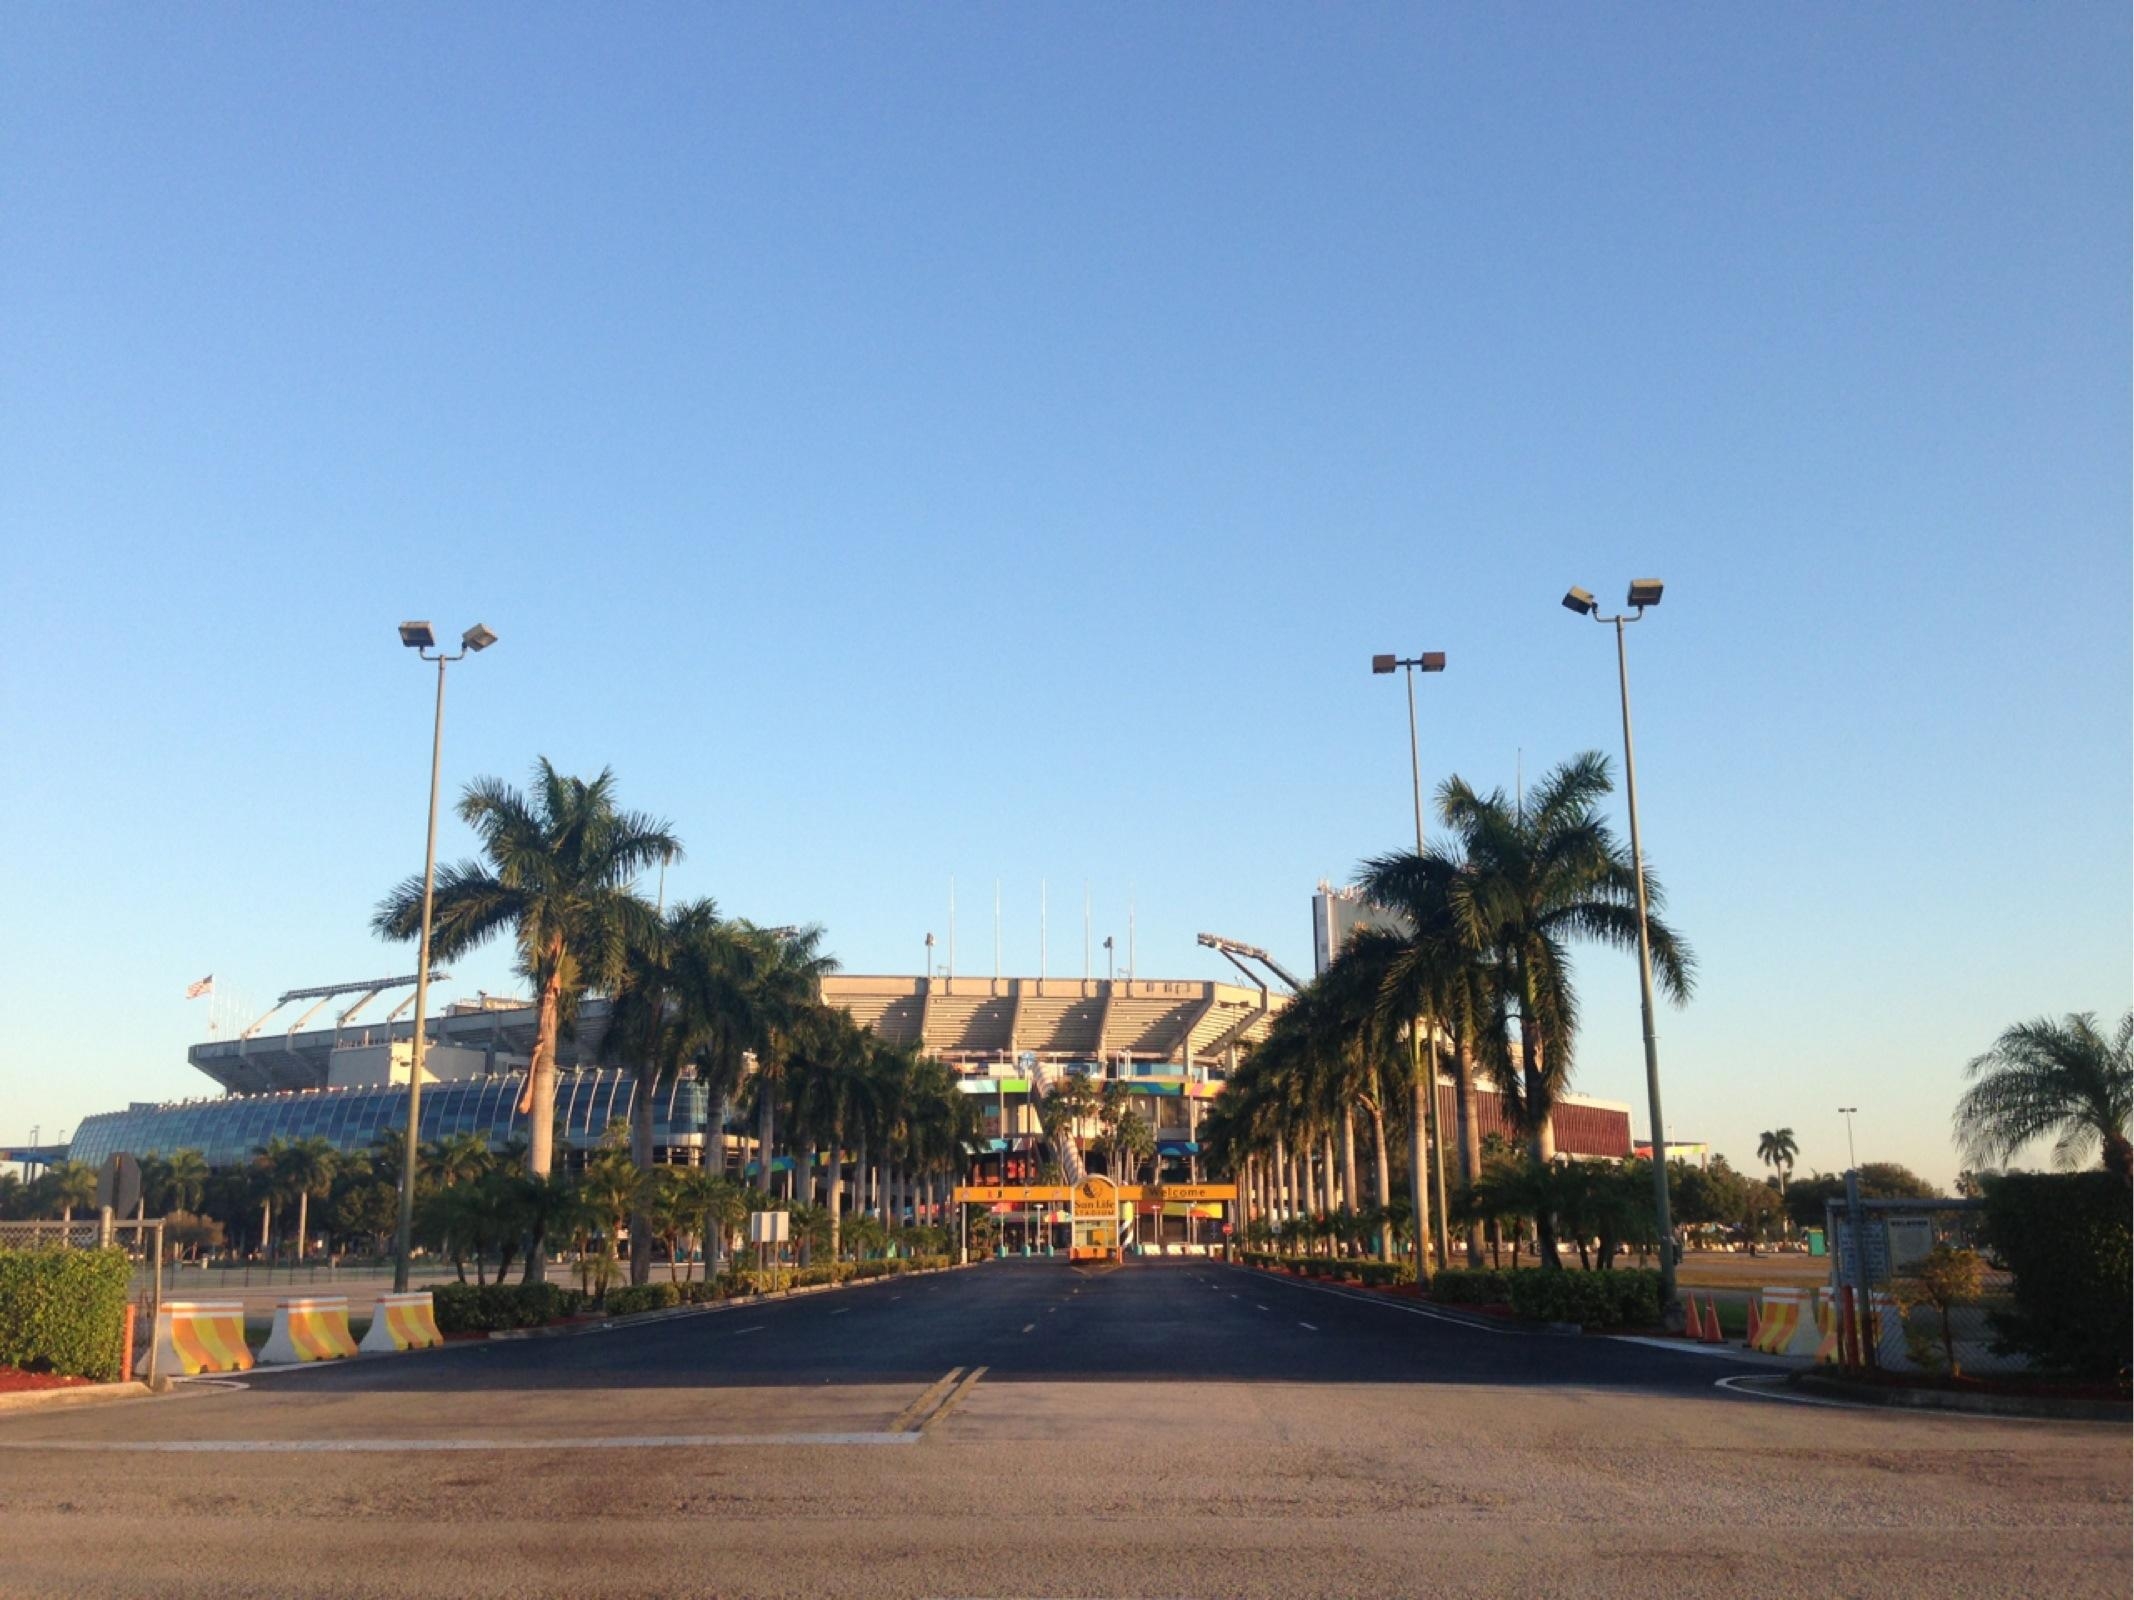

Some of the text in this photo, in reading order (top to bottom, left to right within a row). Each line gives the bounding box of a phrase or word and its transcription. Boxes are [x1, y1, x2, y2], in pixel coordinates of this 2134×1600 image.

[1149, 1187, 1205, 1197] Welcome
[1075, 1199, 1114, 1209] Sun Life
